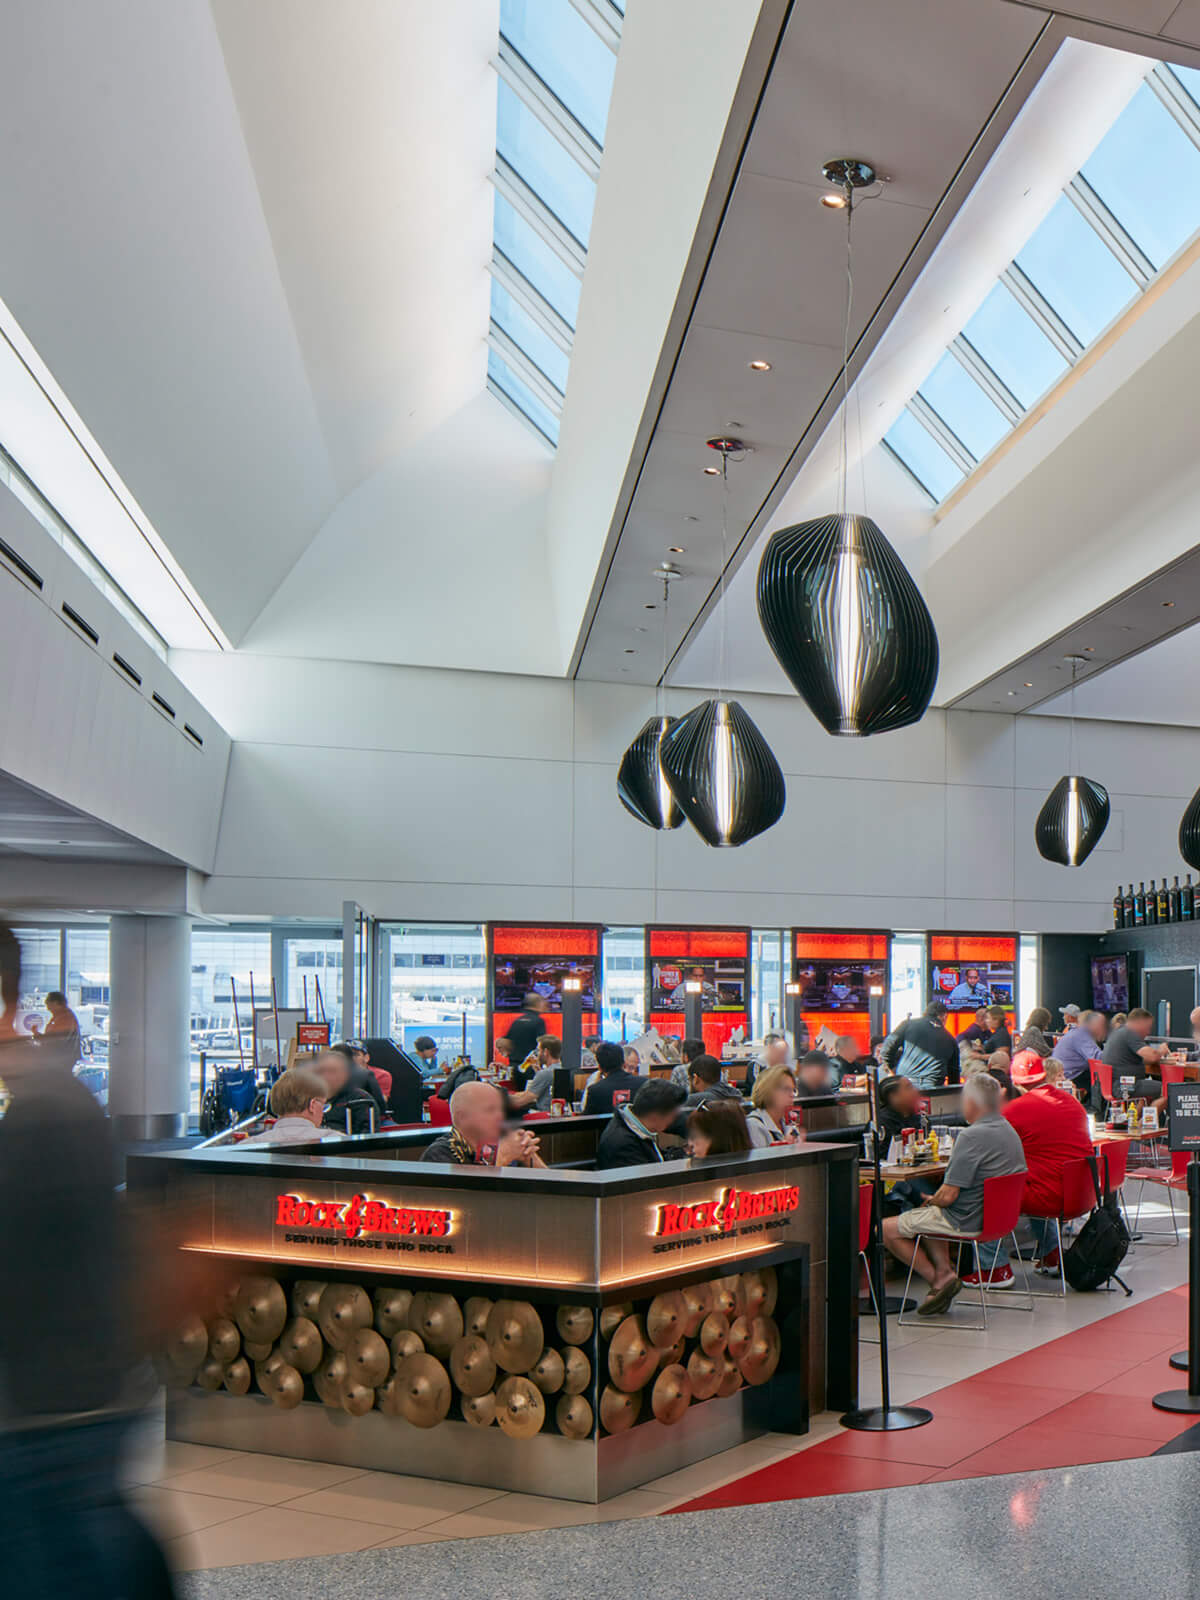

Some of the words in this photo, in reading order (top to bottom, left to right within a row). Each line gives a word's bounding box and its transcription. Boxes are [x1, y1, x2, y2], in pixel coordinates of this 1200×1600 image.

[276, 1195, 343, 1229] ROCK
[363, 1201, 449, 1236] BREWS
[661, 1202, 721, 1236] ROCK
[736, 1185, 800, 1221] BREWS
[285, 1233, 338, 1246] SERVING
[341, 1237, 383, 1249] THOSE
[386, 1241, 414, 1251] WHO
[418, 1243, 455, 1254] ROCK
[653, 1236, 702, 1253] SERVING
[704, 1229, 737, 1244] THOSE
[740, 1223, 763, 1236] WHO
[765, 1217, 791, 1230] ROCK
